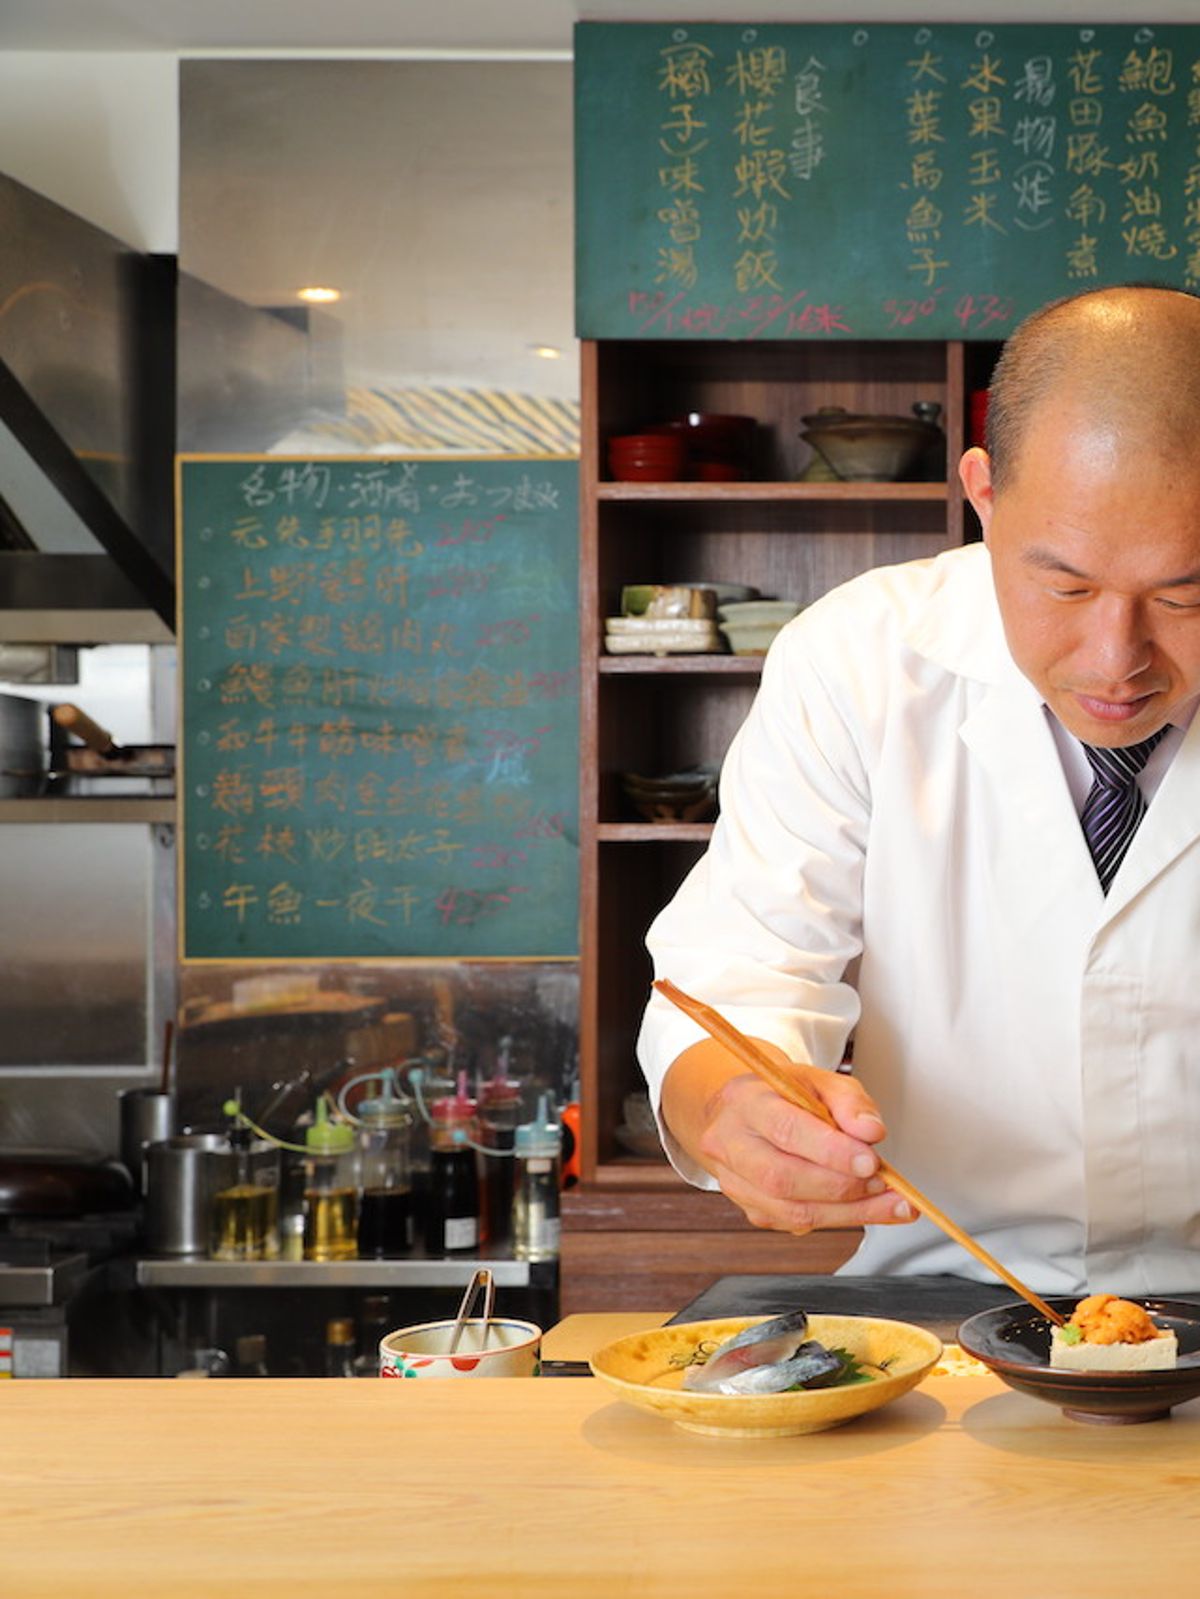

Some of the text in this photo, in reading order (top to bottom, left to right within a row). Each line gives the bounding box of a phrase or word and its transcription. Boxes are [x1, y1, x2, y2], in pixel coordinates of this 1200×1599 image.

[788, 56, 829, 180] 食事
[962, 53, 1007, 236] 水果玉米
